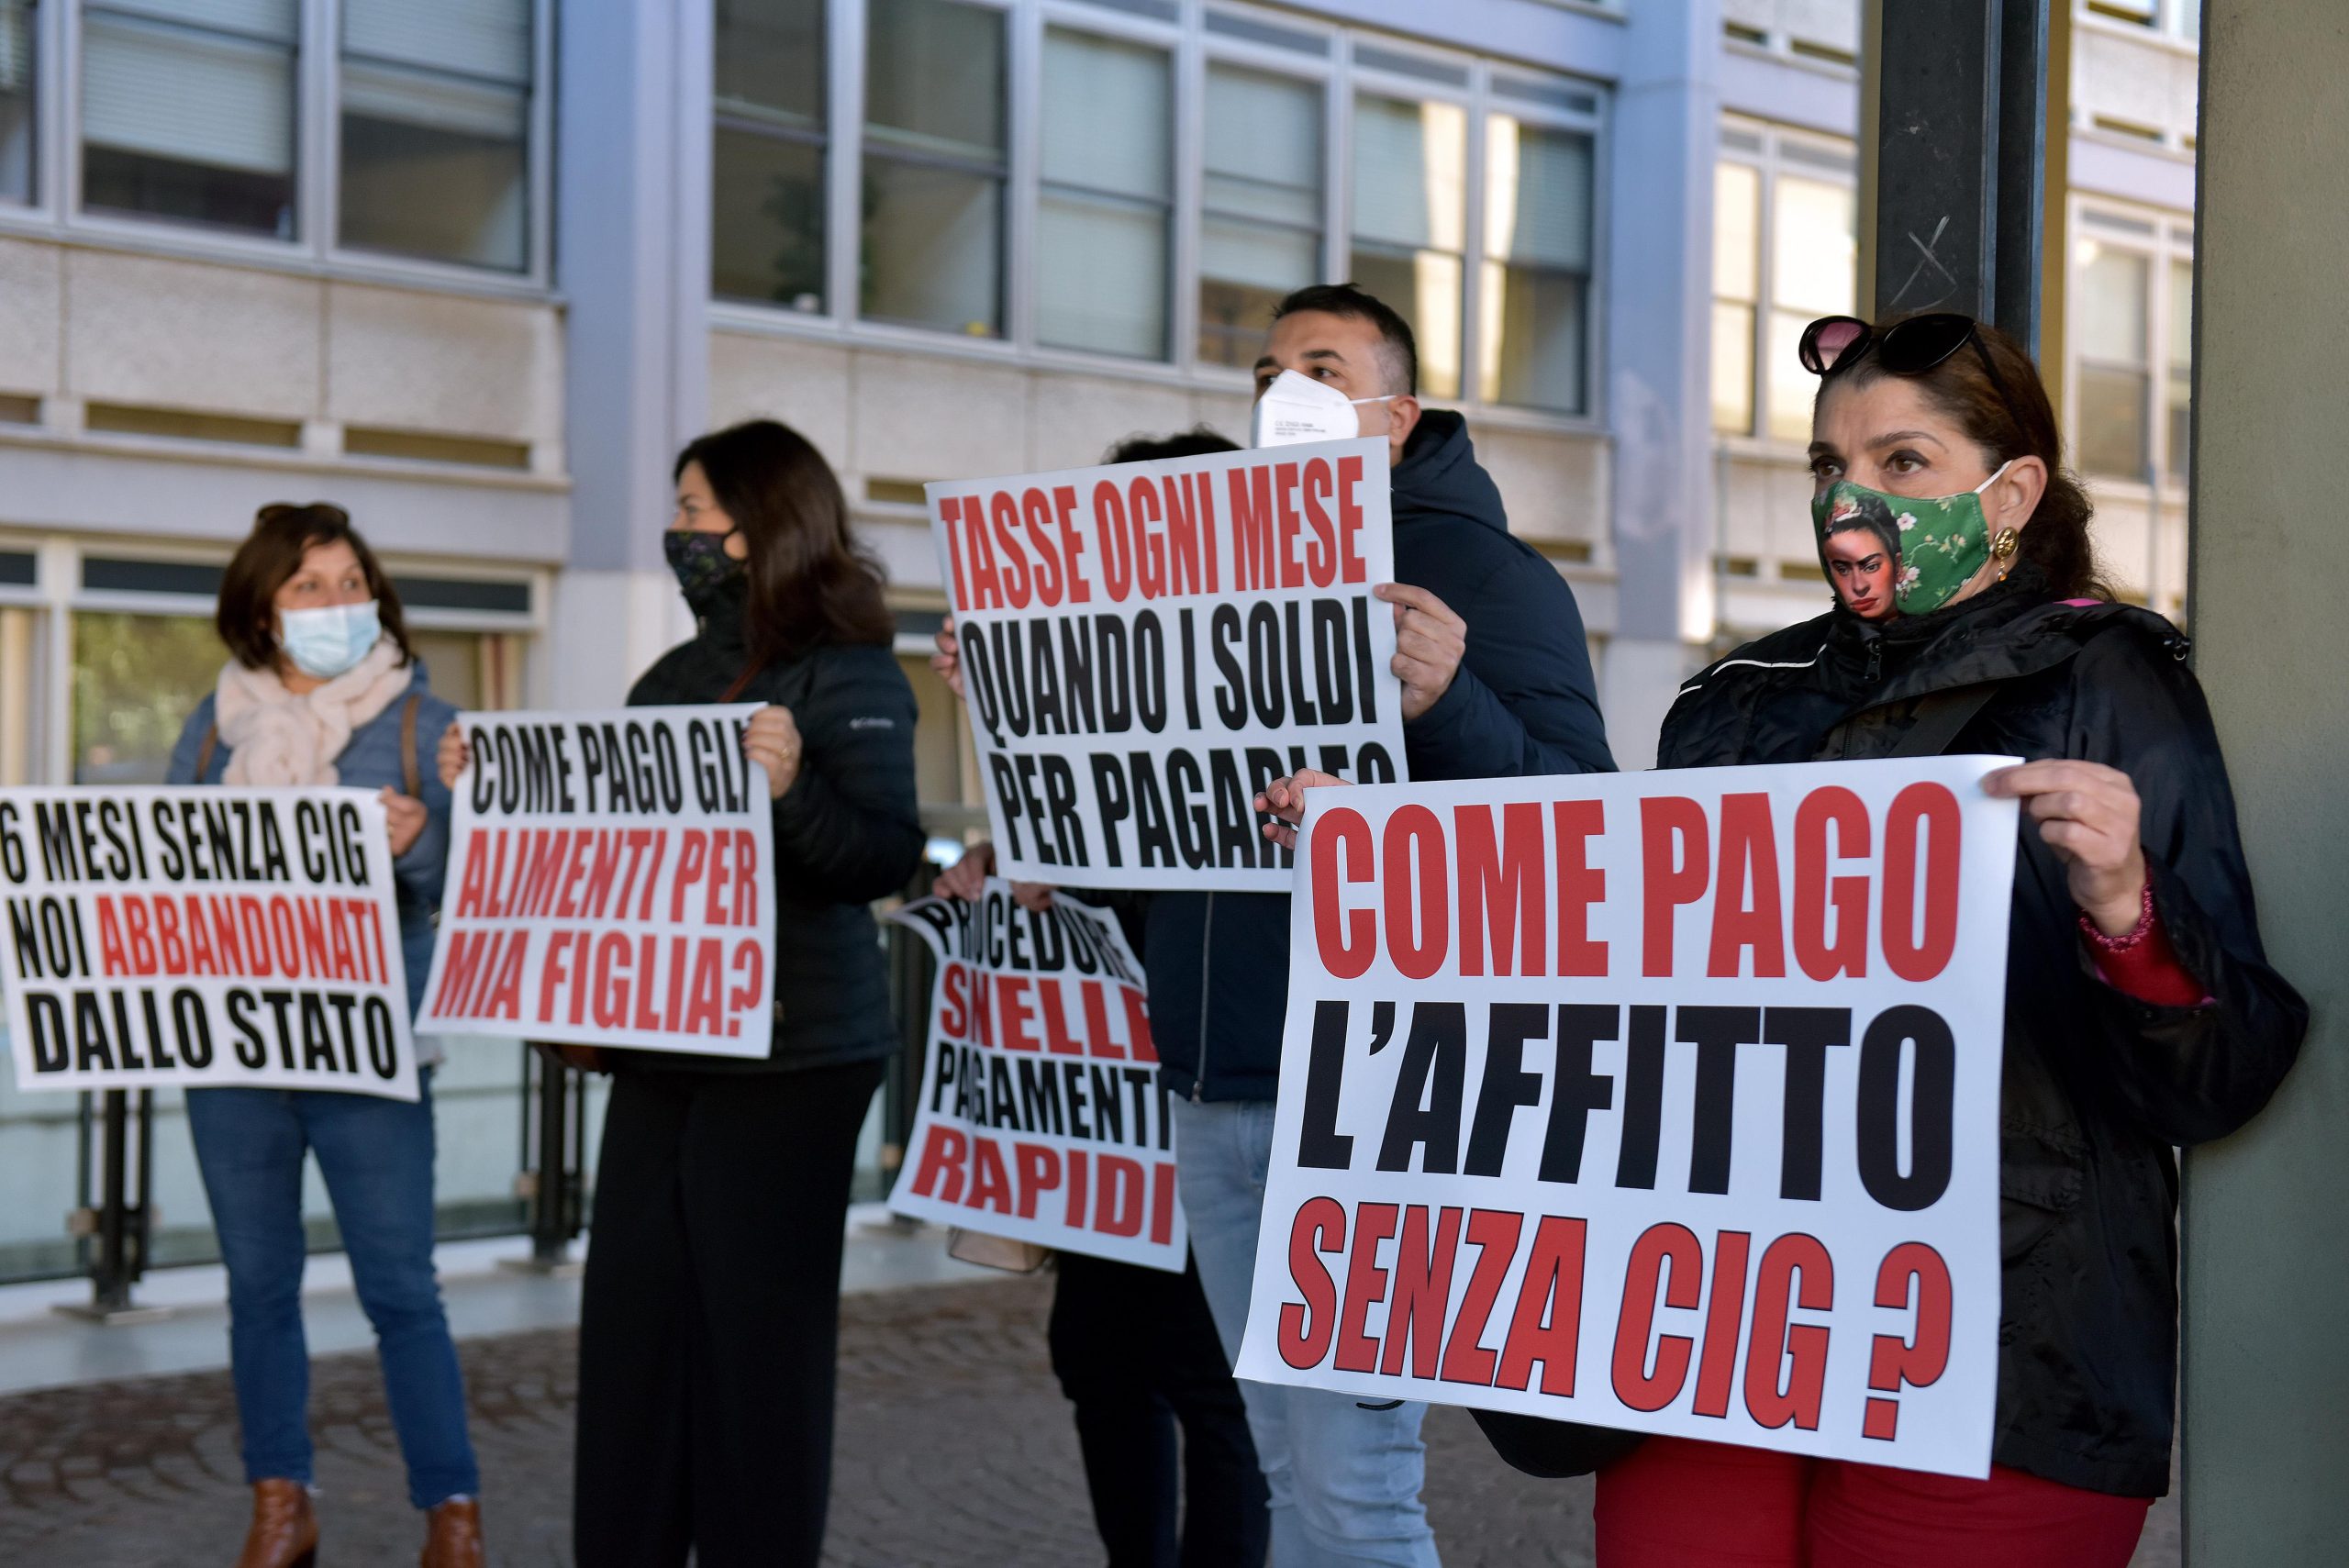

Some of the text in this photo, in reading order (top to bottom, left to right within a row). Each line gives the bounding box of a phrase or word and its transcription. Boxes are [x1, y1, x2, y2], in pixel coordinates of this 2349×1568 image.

[940, 456, 1366, 611] TASSE OGNI MESE
[960, 596, 1377, 748] QUANDO I SOLDI
[471, 717, 751, 815] COME PAGO GLI
[989, 751, 1089, 867] PER
[35, 798, 148, 882] MESI
[153, 799, 291, 882] SENZA
[295, 800, 370, 886] CIG
[455, 828, 758, 928] ALIMENTI PER
[1311, 781, 1962, 982] COME PAGO
[7, 893, 390, 985] NOI ABBANDONATI
[431, 929, 763, 1037] MIA FIGLIA?
[25, 987, 396, 1080] DALLO STATO
[930, 1040, 1171, 1151] PAGAMENTI
[1297, 1000, 1955, 1212] L'AFFITTO
[910, 1123, 1175, 1246] RAPIDI
[1277, 1196, 1953, 1441] SENZA CIG ?
